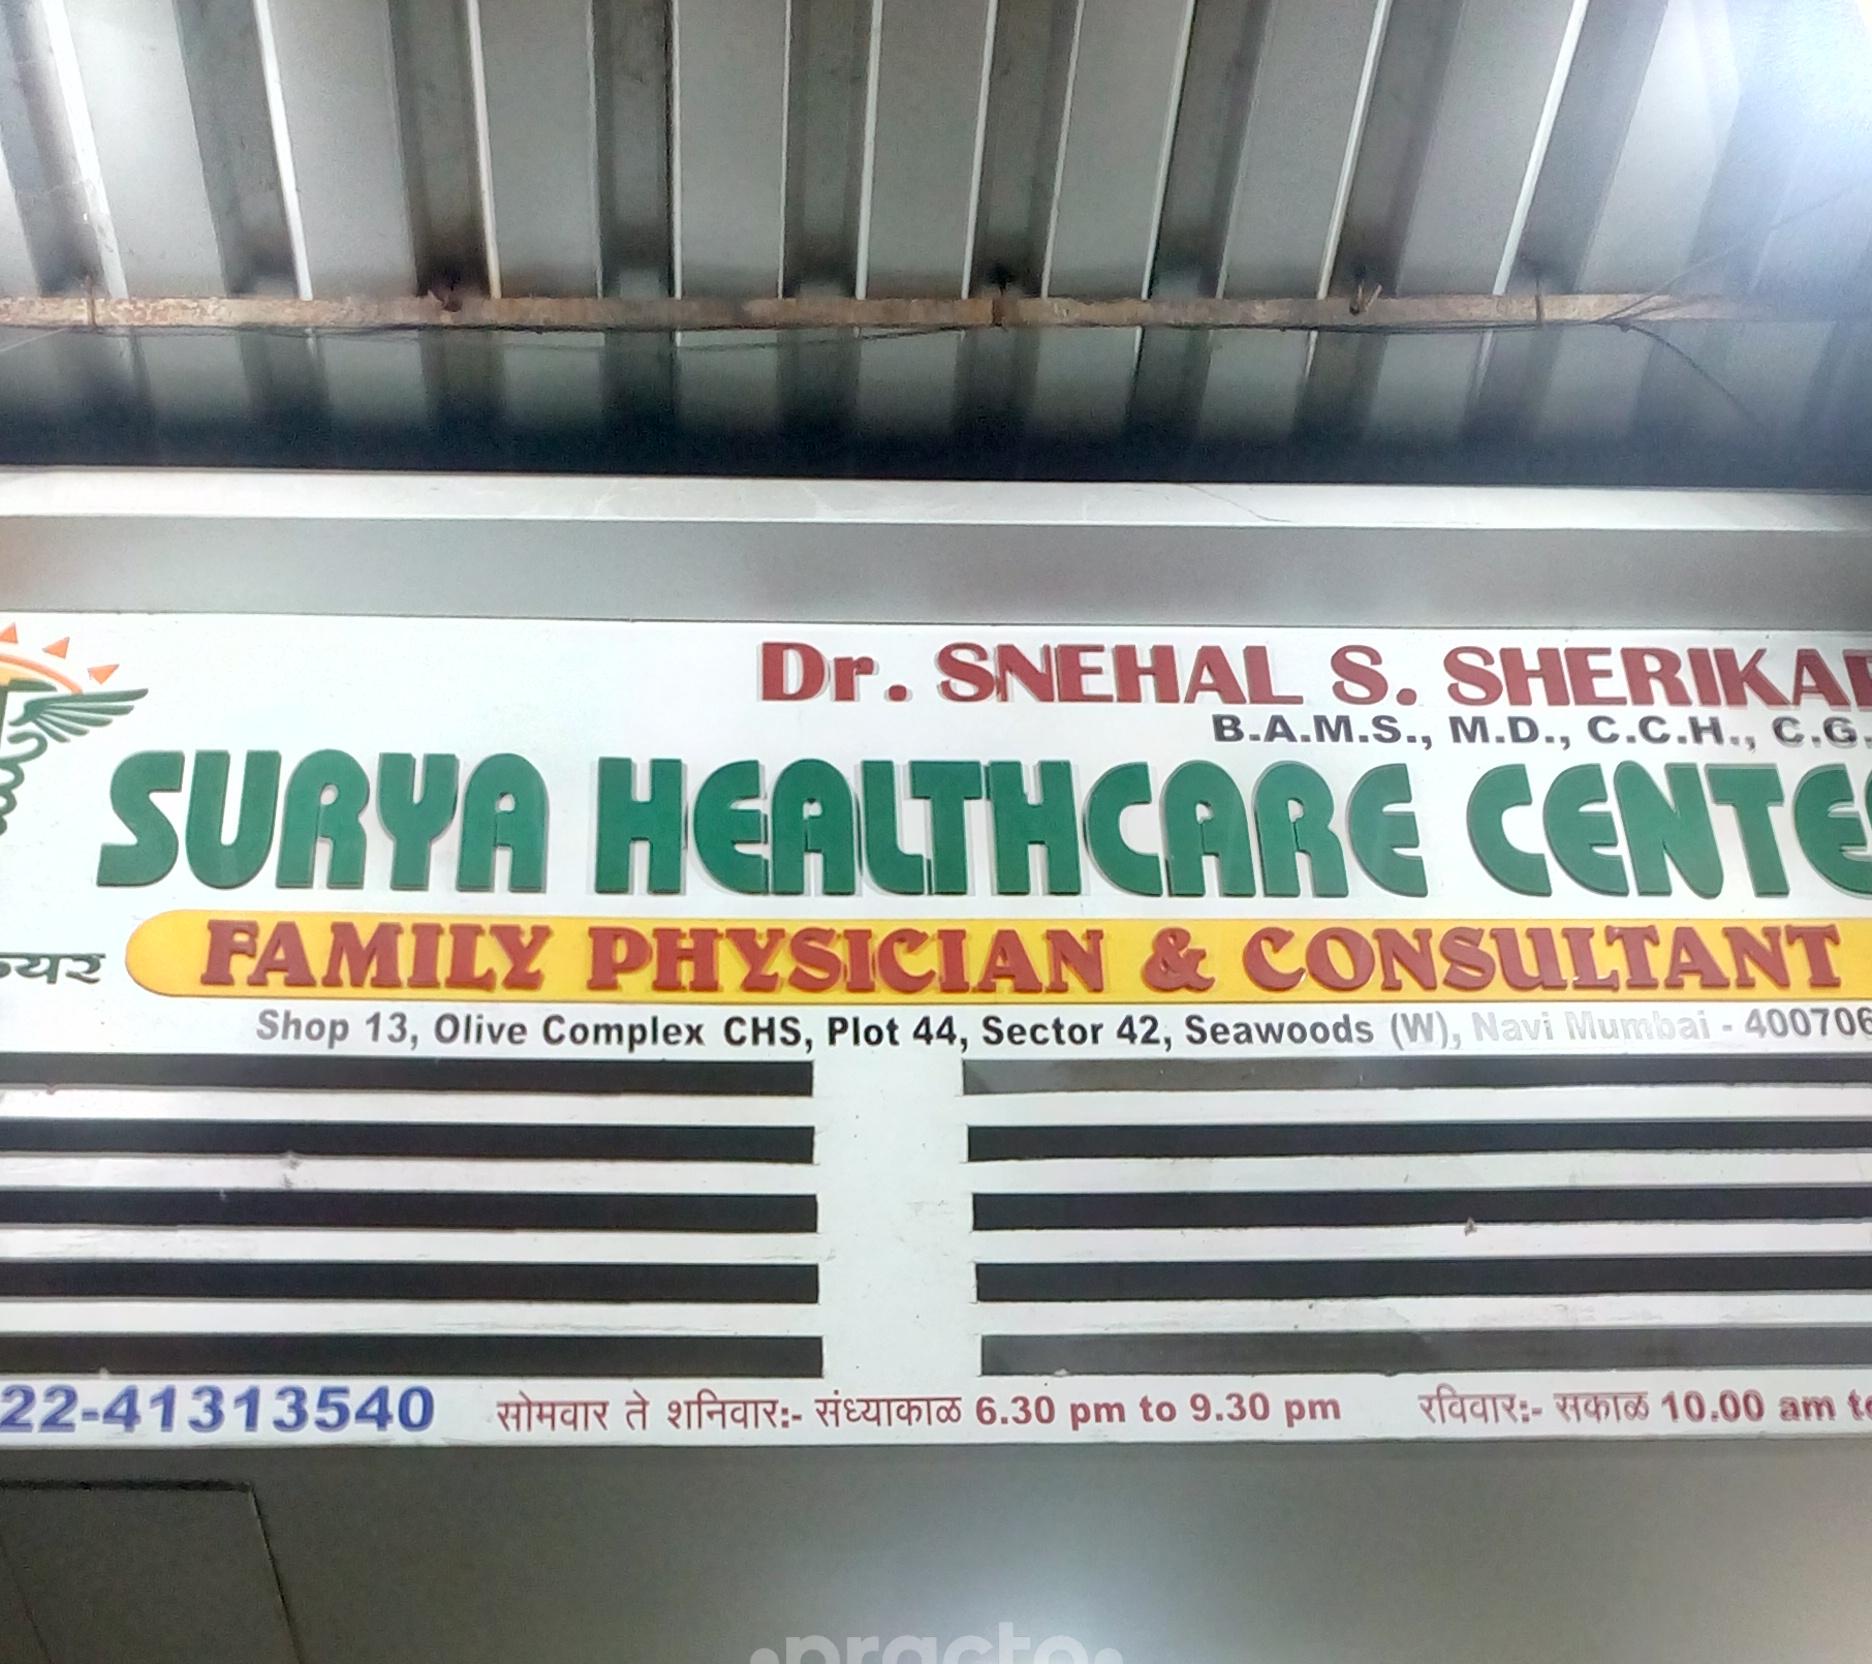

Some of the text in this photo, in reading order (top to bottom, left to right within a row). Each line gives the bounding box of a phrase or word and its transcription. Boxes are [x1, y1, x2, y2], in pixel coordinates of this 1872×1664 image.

[757, 641, 911, 701] Dr.
[936, 642, 1304, 704] SNEHAL
[1330, 645, 1417, 706] S.
[1213, 713, 1432, 750] B.A.M.S.,
[1450, 716, 1570, 751] M.D.,
[1587, 716, 1756, 752] C.C.H.,
[97, 749, 1872, 900] SURYA HEALTHCARE CENTE
[0, 951, 106, 985] यर
[200, 919, 1841, 993] FAMILY PHYSICIAN & CONSULTANT
[256, 1009, 349, 1048] Shop
[364, 1012, 419, 1049] 13,
[434, 1013, 528, 1045] Olive
[542, 1014, 705, 1053] Complex
[723, 1016, 813, 1053] CHS,
[828, 1016, 900, 1047] Plot
[912, 1016, 968, 1053] 44,
[982, 1016, 1103, 1047] Sector
[1116, 1016, 1172, 1052] 42,
[1185, 1013, 1374, 1045] Seawoods
[1390, 1010, 1461, 1050] (W),
[1473, 1012, 1554, 1041] Navi
[1566, 1010, 1711, 1040] Mumbai
[1744, 1007, 1872, 1040] 400706
[0, 1385, 435, 1433] 22-41313540
[497, 1391, 609, 1432] सोमवार
[625, 1391, 650, 1431] ते
[815, 1390, 962, 1428] संध्याकाळ
[976, 1396, 1055, 1424] 6.30
[1071, 1397, 1126, 1431] pm
[1141, 1395, 1177, 1423] to
[1190, 1393, 1270, 1422] 9.30
[1285, 1395, 1341, 1428] pm
[1553, 1391, 1649, 1422] सकाळ
[1663, 1390, 1764, 1422] 10.00
[1780, 1396, 1836, 1421] am
